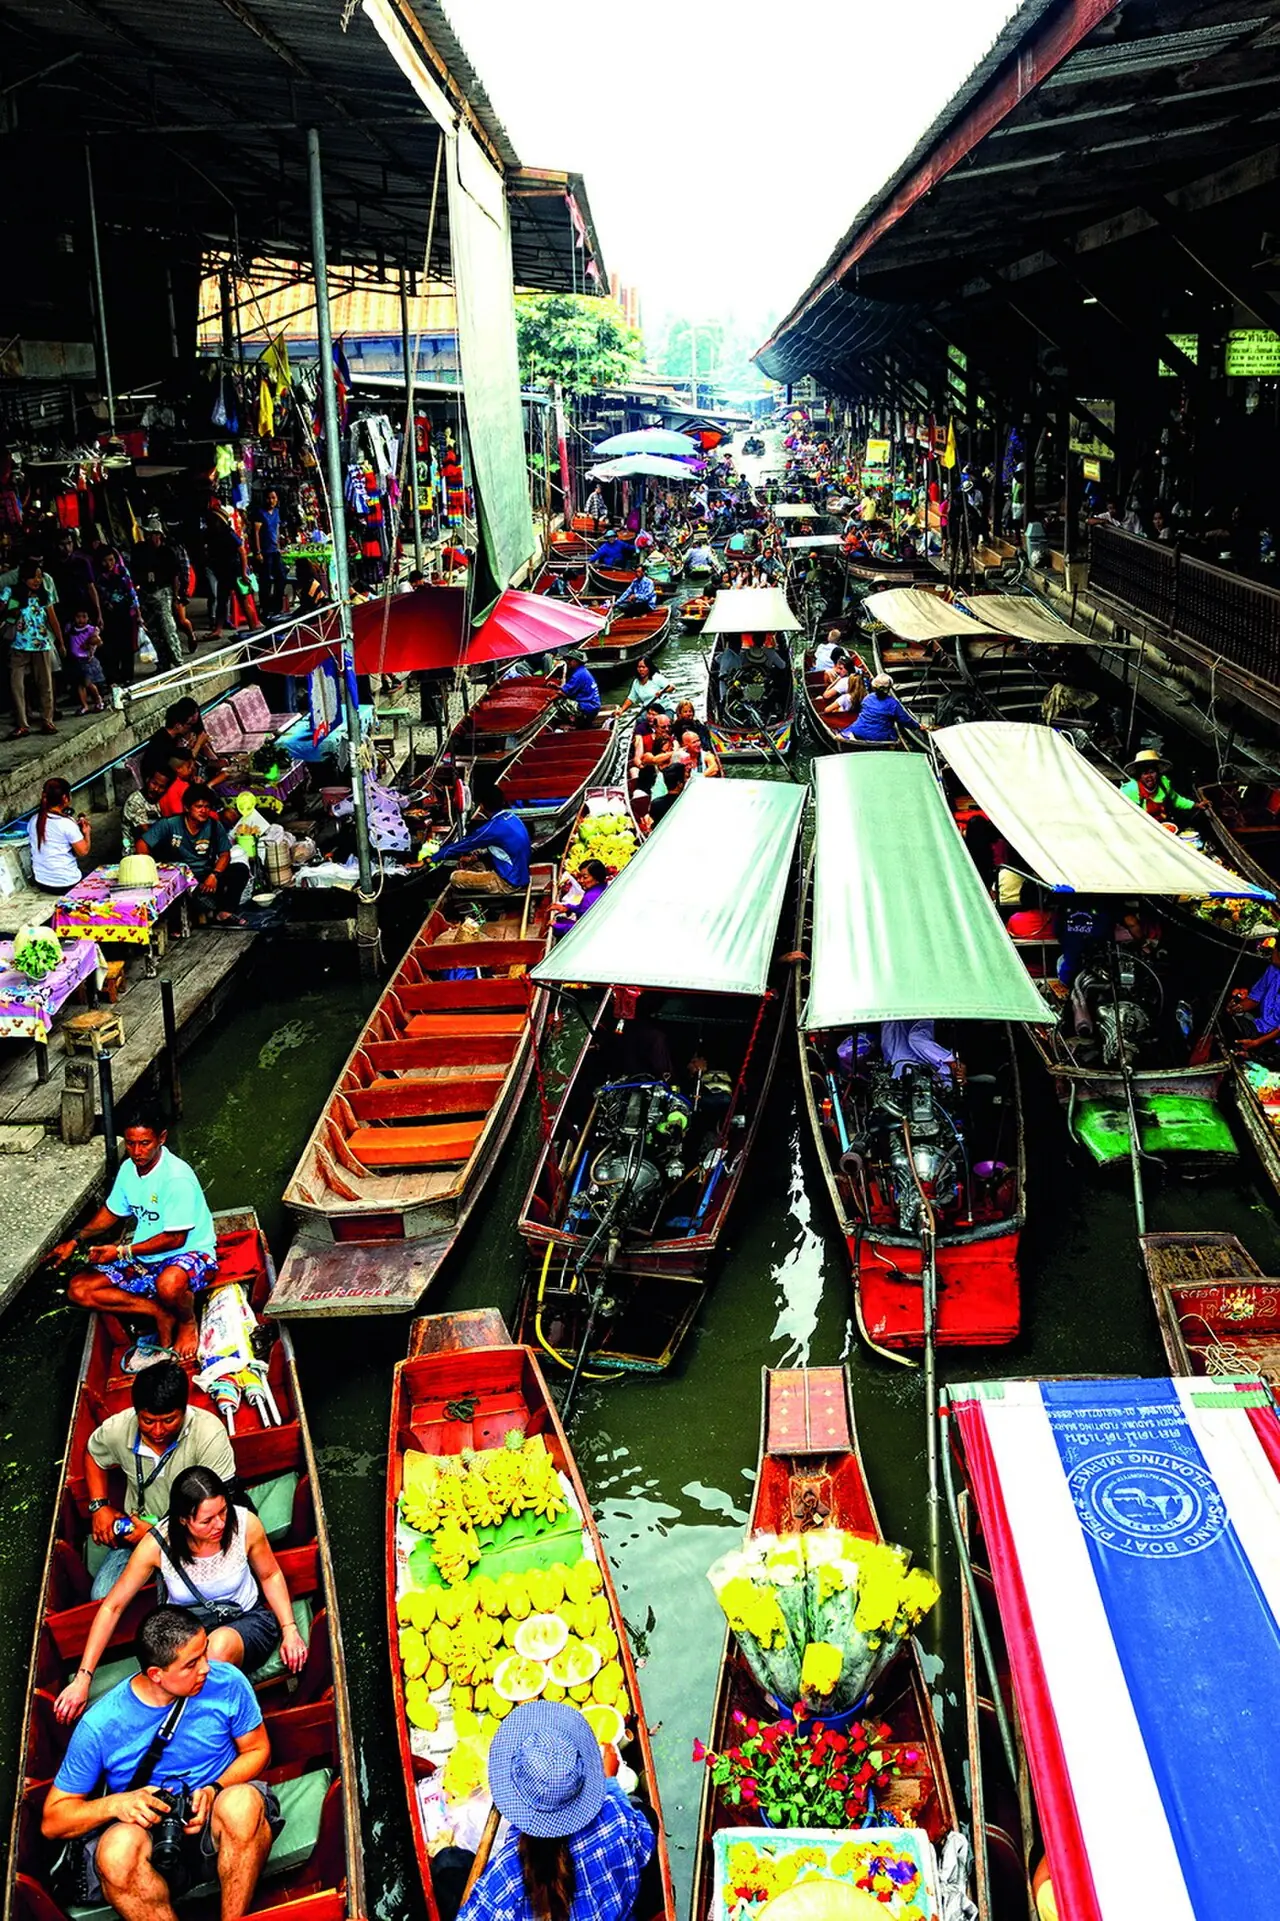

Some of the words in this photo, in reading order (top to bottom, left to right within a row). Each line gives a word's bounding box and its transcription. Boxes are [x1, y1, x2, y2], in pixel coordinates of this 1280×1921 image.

[1237, 785, 1248, 798] 7
[1071, 1454, 1122, 1493] MARKET
[1127, 1453, 1211, 1488] FLOATING
[1079, 1508, 1115, 1541] PIER
[1183, 1504, 1224, 1548] SHANG
[1120, 1538, 1179, 1553] BOAT
